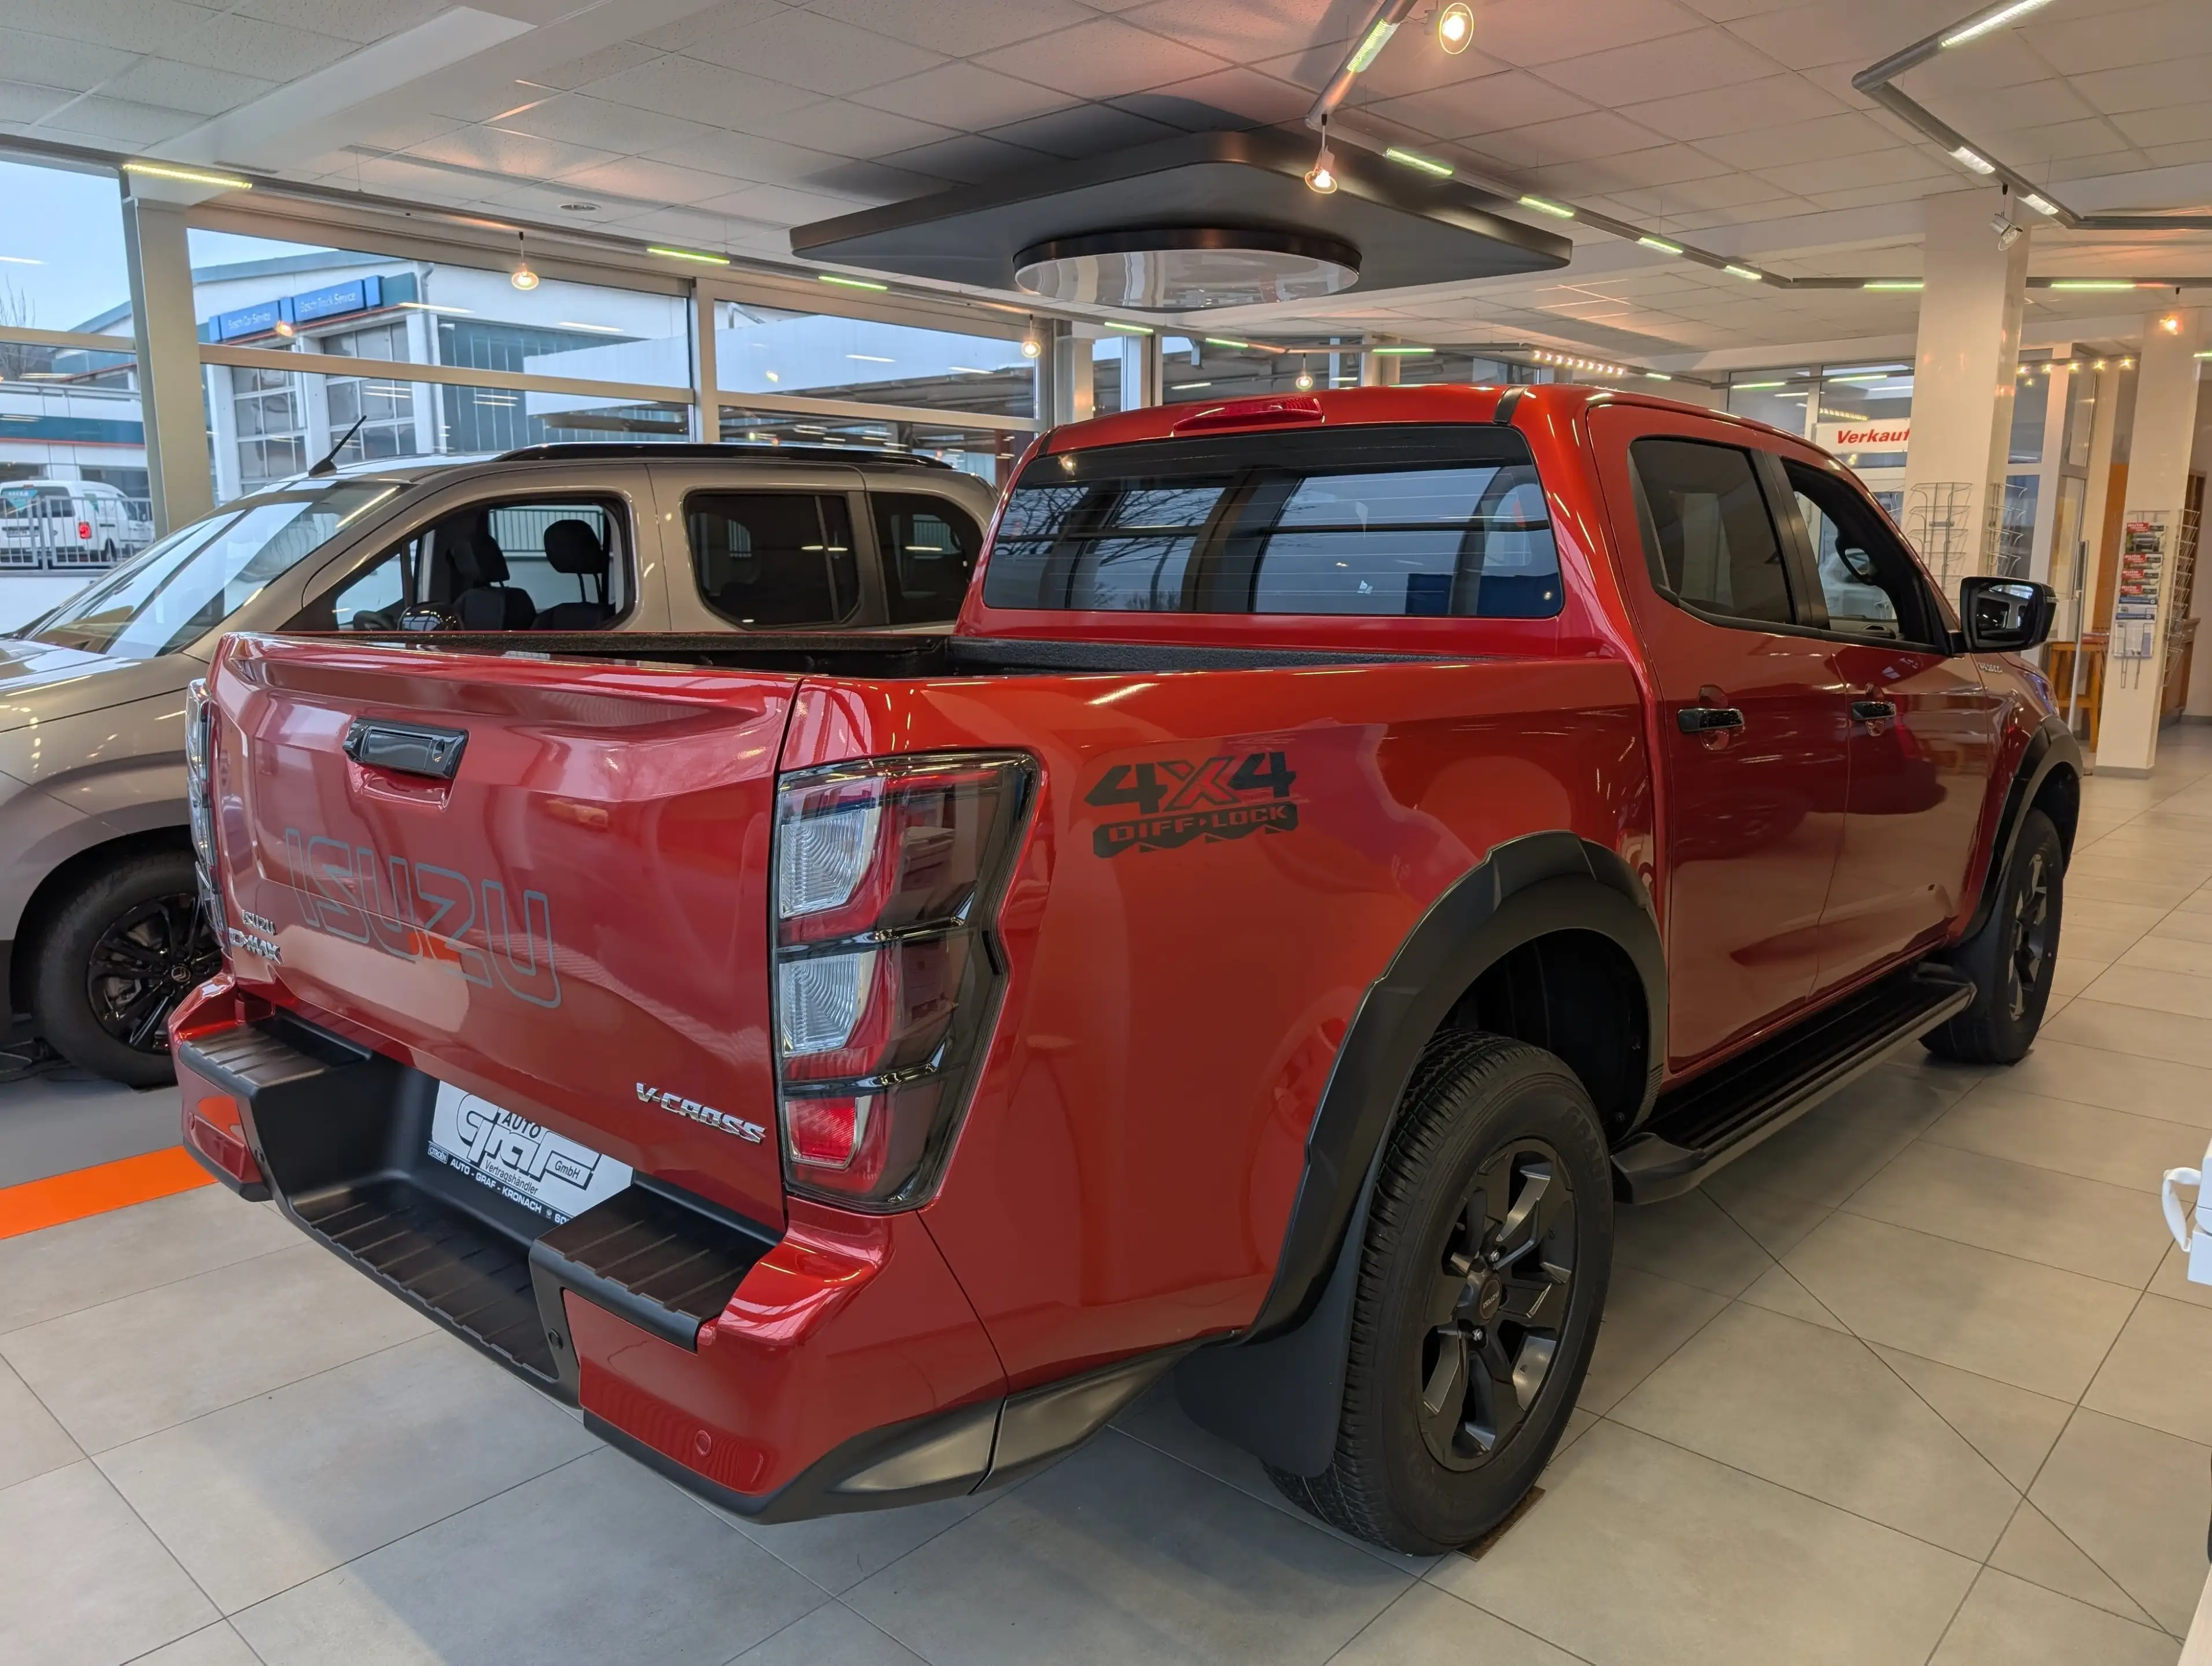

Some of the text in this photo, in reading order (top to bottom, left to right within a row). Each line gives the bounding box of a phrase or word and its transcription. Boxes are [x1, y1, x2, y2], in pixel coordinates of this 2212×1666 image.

[242, 909, 276, 936] ISUZU
[285, 827, 562, 1009] ISUZU
[228, 927, 285, 965] D-MAX
[502, 1111, 541, 1139] AUTO
[636, 1082, 767, 1144] V-CROSS
[450, 1158, 470, 1175] AUTO
[475, 1171, 497, 1188] GRAF
[502, 1186, 543, 1214] KRONACH
[485, 1160, 539, 1196] Vertragshändler
[555, 1160, 581, 1180] GmbH
[1483, 1291, 1499, 1309] ISUZU
